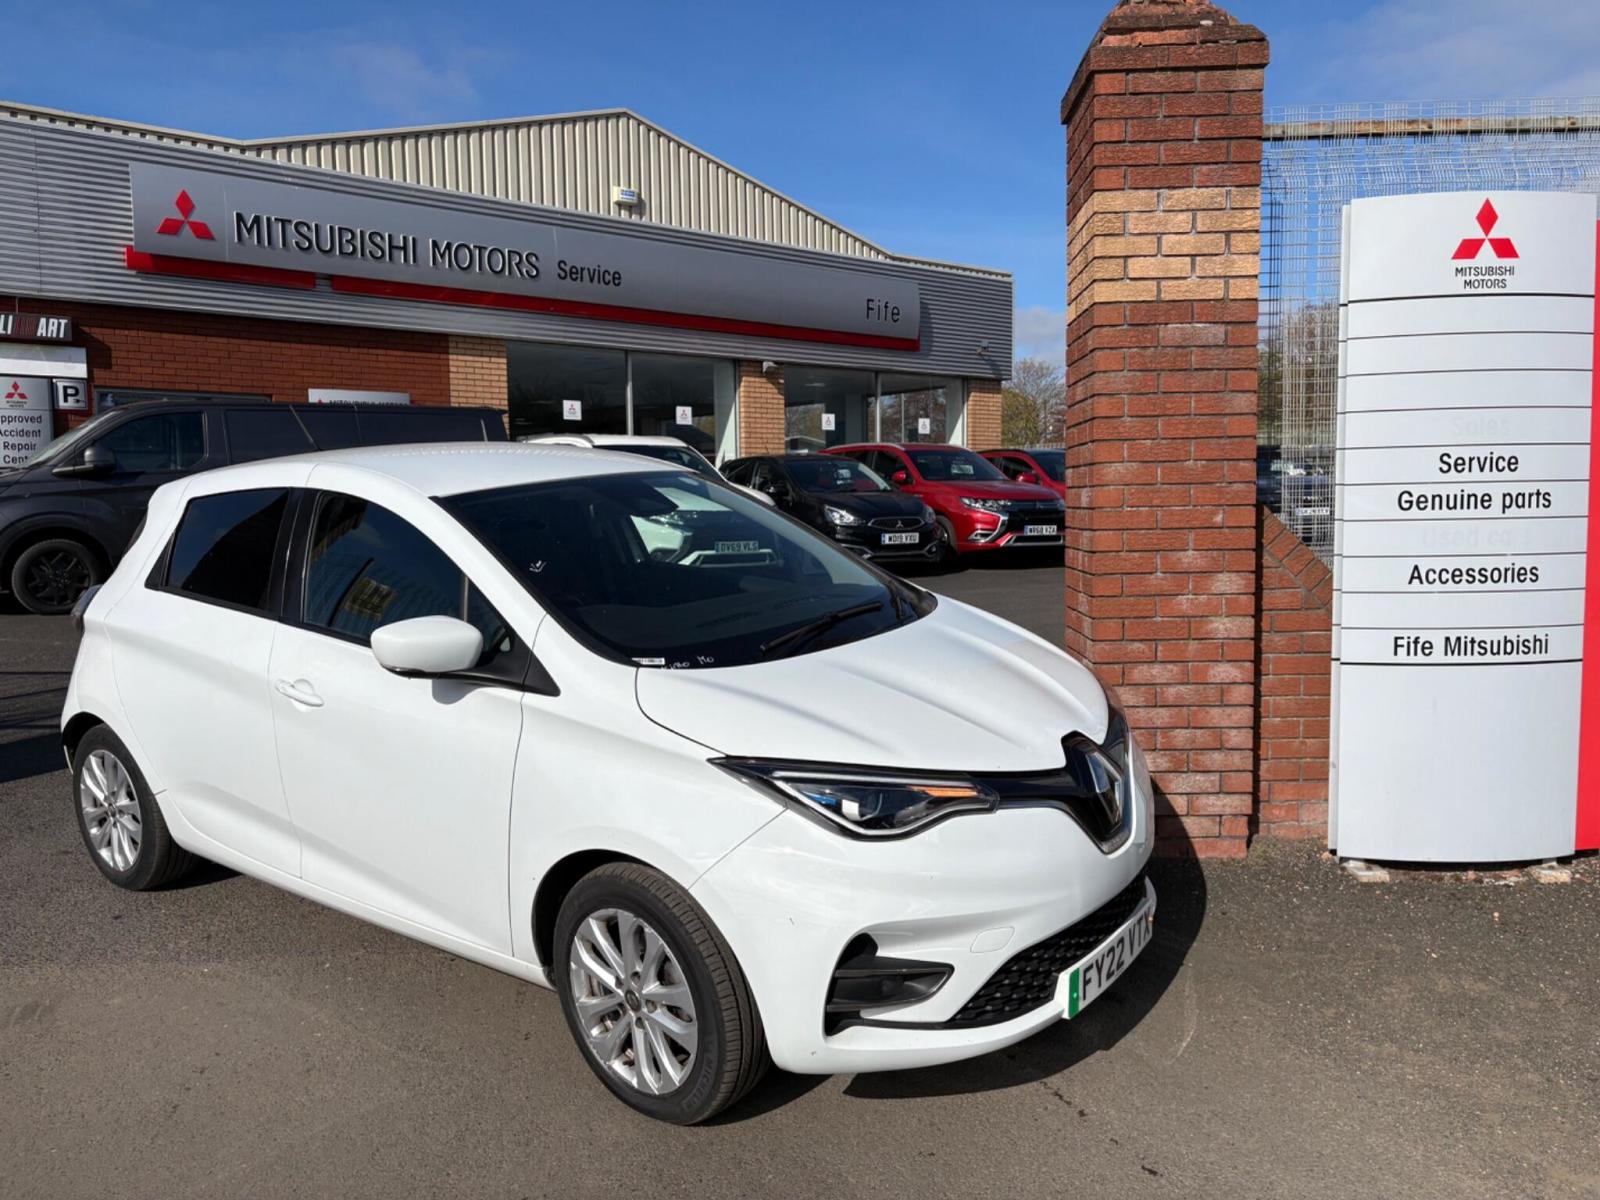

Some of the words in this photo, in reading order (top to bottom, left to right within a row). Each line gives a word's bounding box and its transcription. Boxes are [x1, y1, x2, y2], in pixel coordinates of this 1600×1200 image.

[233, 209, 419, 266] MITSUBISHI
[429, 238, 540, 280] MOTORS
[556, 260, 623, 288] Service
[1454, 265, 1515, 278] MITSUBISHI
[1463, 278, 1508, 290] MOTORS
[865, 298, 901, 324] Fife
[3, 441, 38, 453] Repair
[1438, 451, 1520, 475] Service
[1397, 488, 1493, 512] Genuine
[1501, 488, 1552, 514] parts
[1407, 562, 1540, 586] Accessories
[1392, 635, 1435, 657] Fife
[1443, 633, 1550, 657] Mitsubishi
[1082, 935, 1125, 1001] FY22
